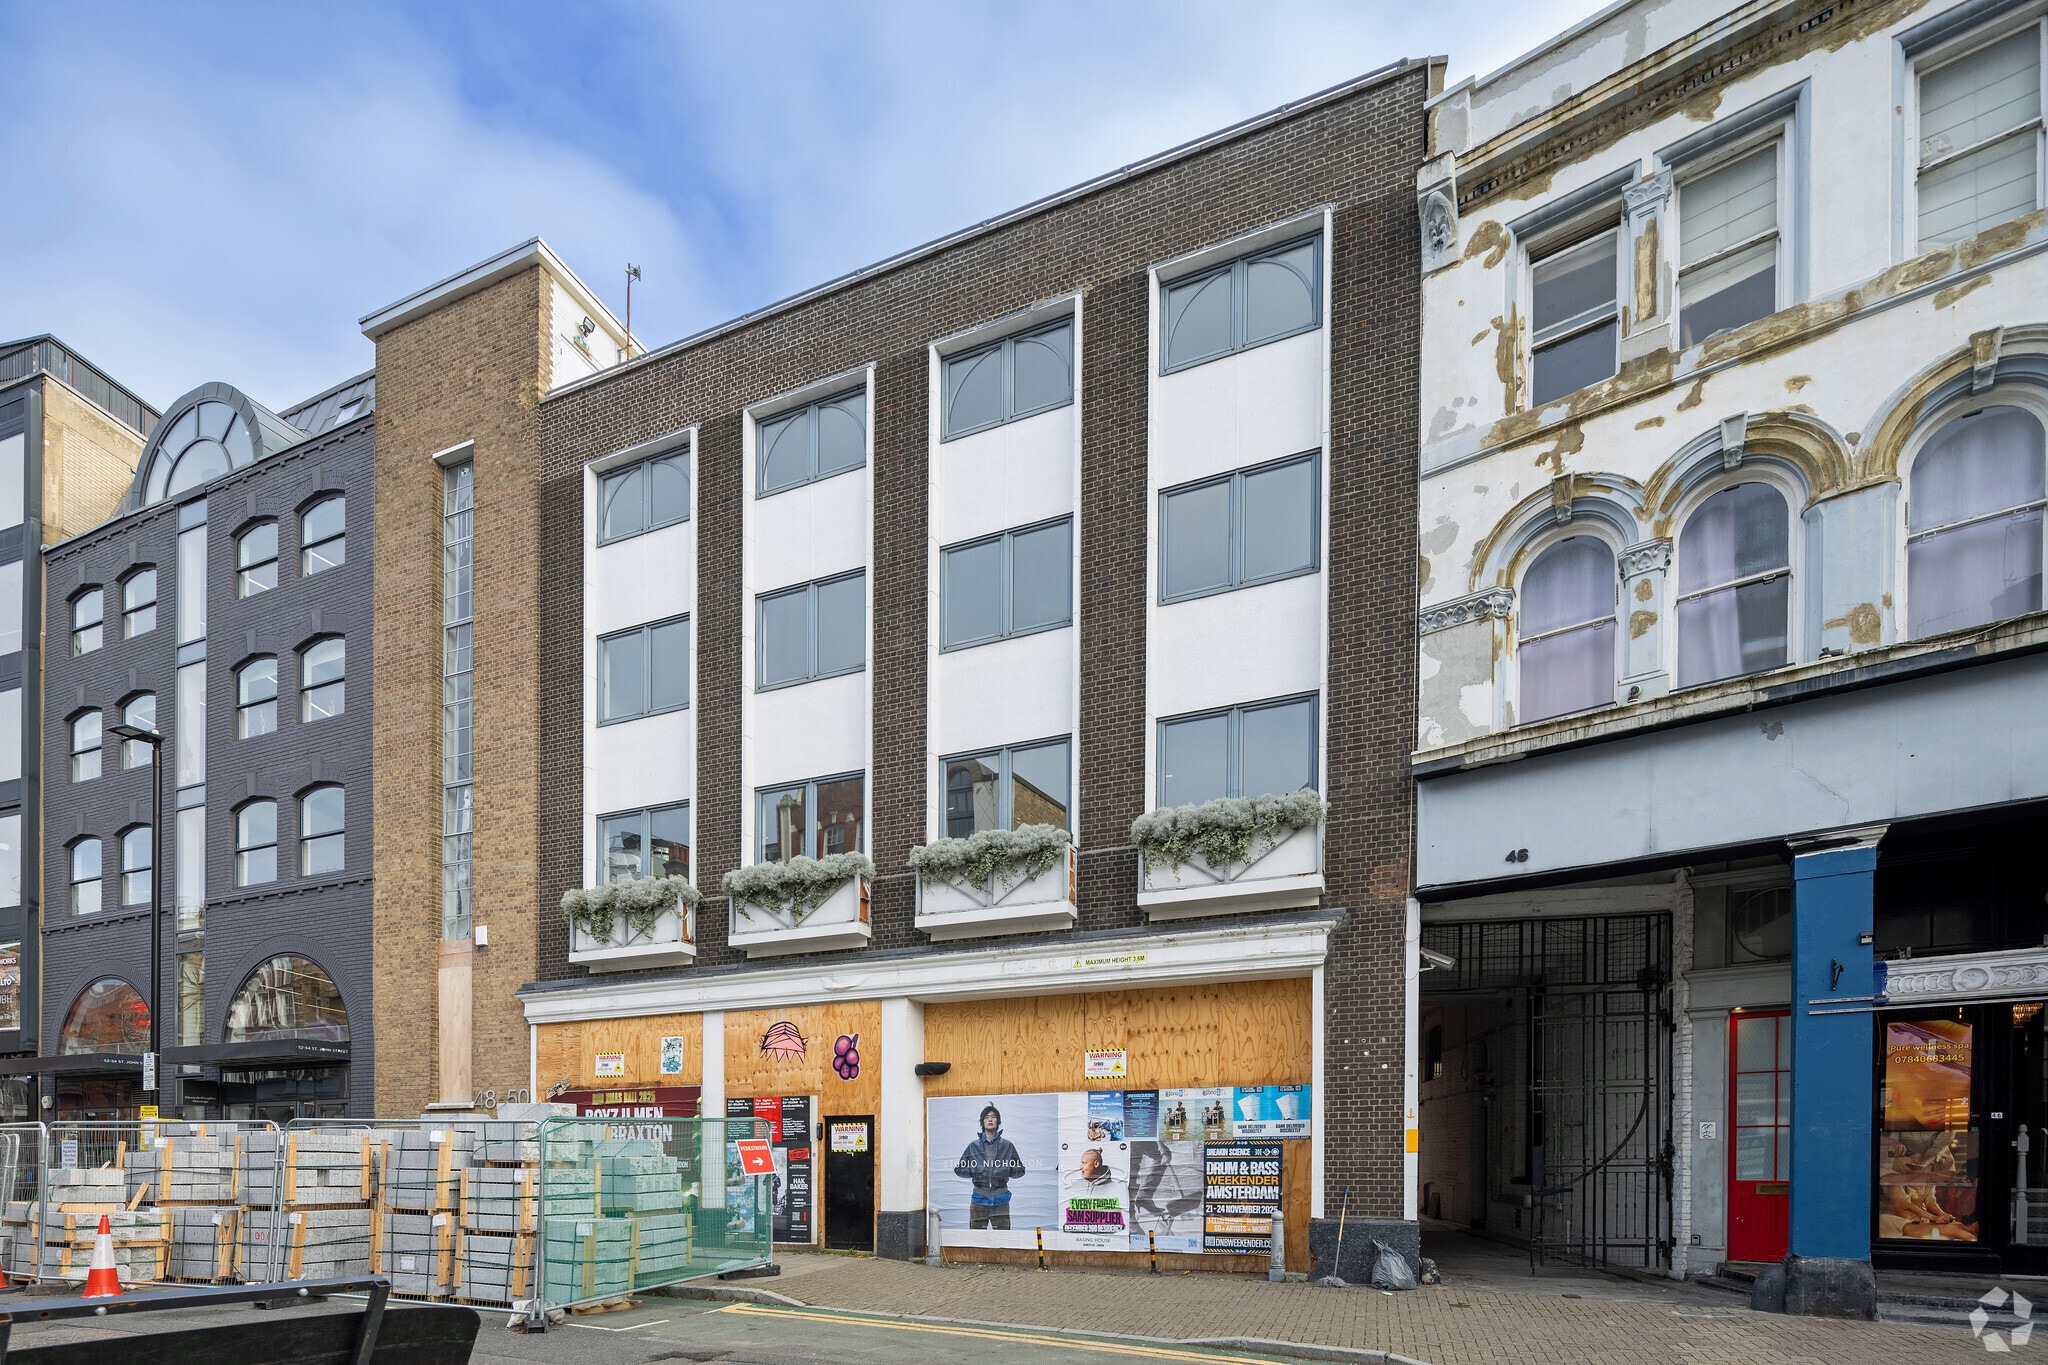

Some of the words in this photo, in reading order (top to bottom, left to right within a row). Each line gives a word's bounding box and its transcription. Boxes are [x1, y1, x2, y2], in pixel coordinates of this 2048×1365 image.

[1505, 848, 1529, 863] 46
[1912, 1043, 1951, 1051] wellness
[1089, 1051, 1123, 1059] WARNING
[1894, 1053, 1965, 1064] 07840683445
[610, 1124, 673, 1141] BRAXTON
[1206, 1148, 1228, 1156] BREAKIN
[1228, 1148, 1251, 1156] SCIENCE
[943, 1159, 978, 1168] STUDIO
[983, 1159, 1043, 1168] NICHOLSON
[1206, 1161, 1239, 1176] DRUM
[1239, 1161, 1249, 1176] &
[1250, 1161, 1279, 1176] BASS
[1206, 1175, 1279, 1185] WEEKENDER
[1206, 1185, 1279, 1200] AMSTERDAM
[1071, 1198, 1092, 1210] EVERY
[1092, 1198, 1117, 1210] FRIDAY
[1225, 1205, 1261, 1214] NOVEMBER
[1261, 1205, 1279, 1214] 2025
[1067, 1210, 1085, 1222] SAM
[1085, 1210, 1121, 1225] SUPPLIER
[1064, 1224, 1089, 1232] DECEMBER
